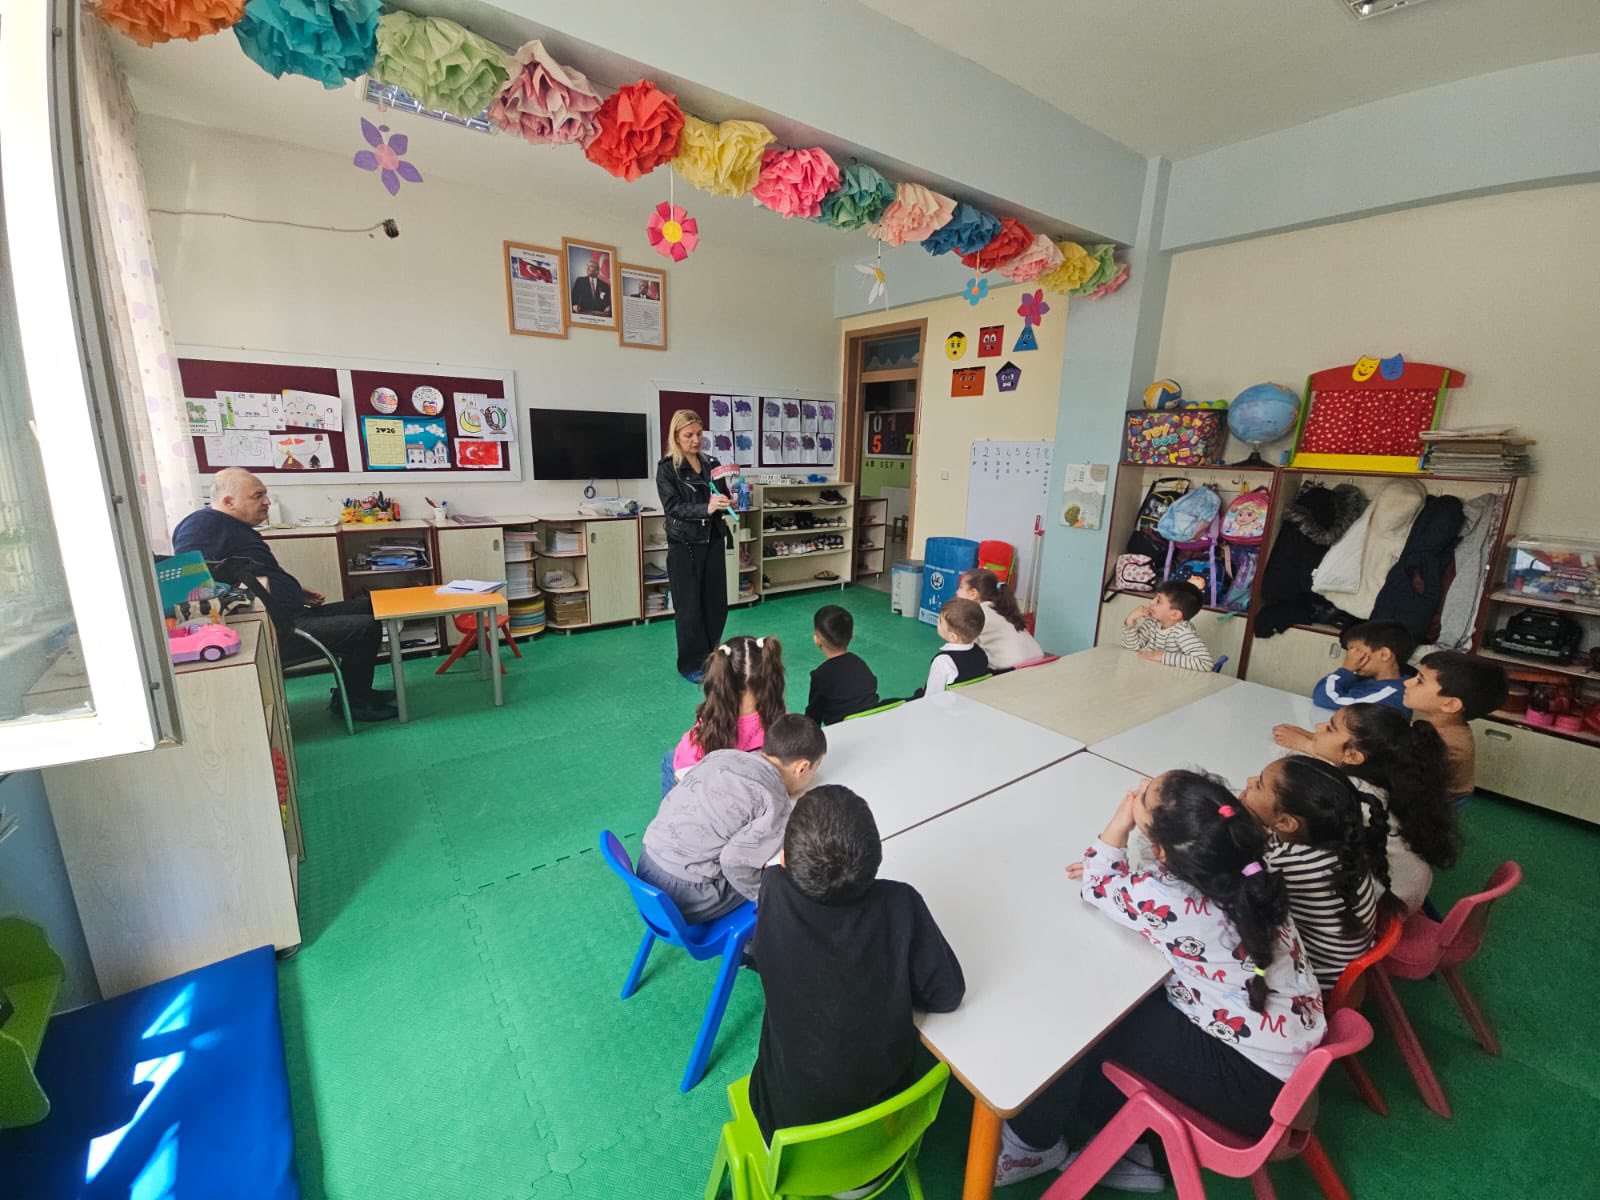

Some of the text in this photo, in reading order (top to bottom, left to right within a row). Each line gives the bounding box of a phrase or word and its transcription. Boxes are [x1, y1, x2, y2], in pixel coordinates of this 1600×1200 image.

[1143, 423, 1170, 440] TOY
[1152, 434, 1179, 448] BOX
[872, 434, 882, 453] 5
[1184, 896, 1212, 916] M
[1259, 1010, 1287, 1038] M
